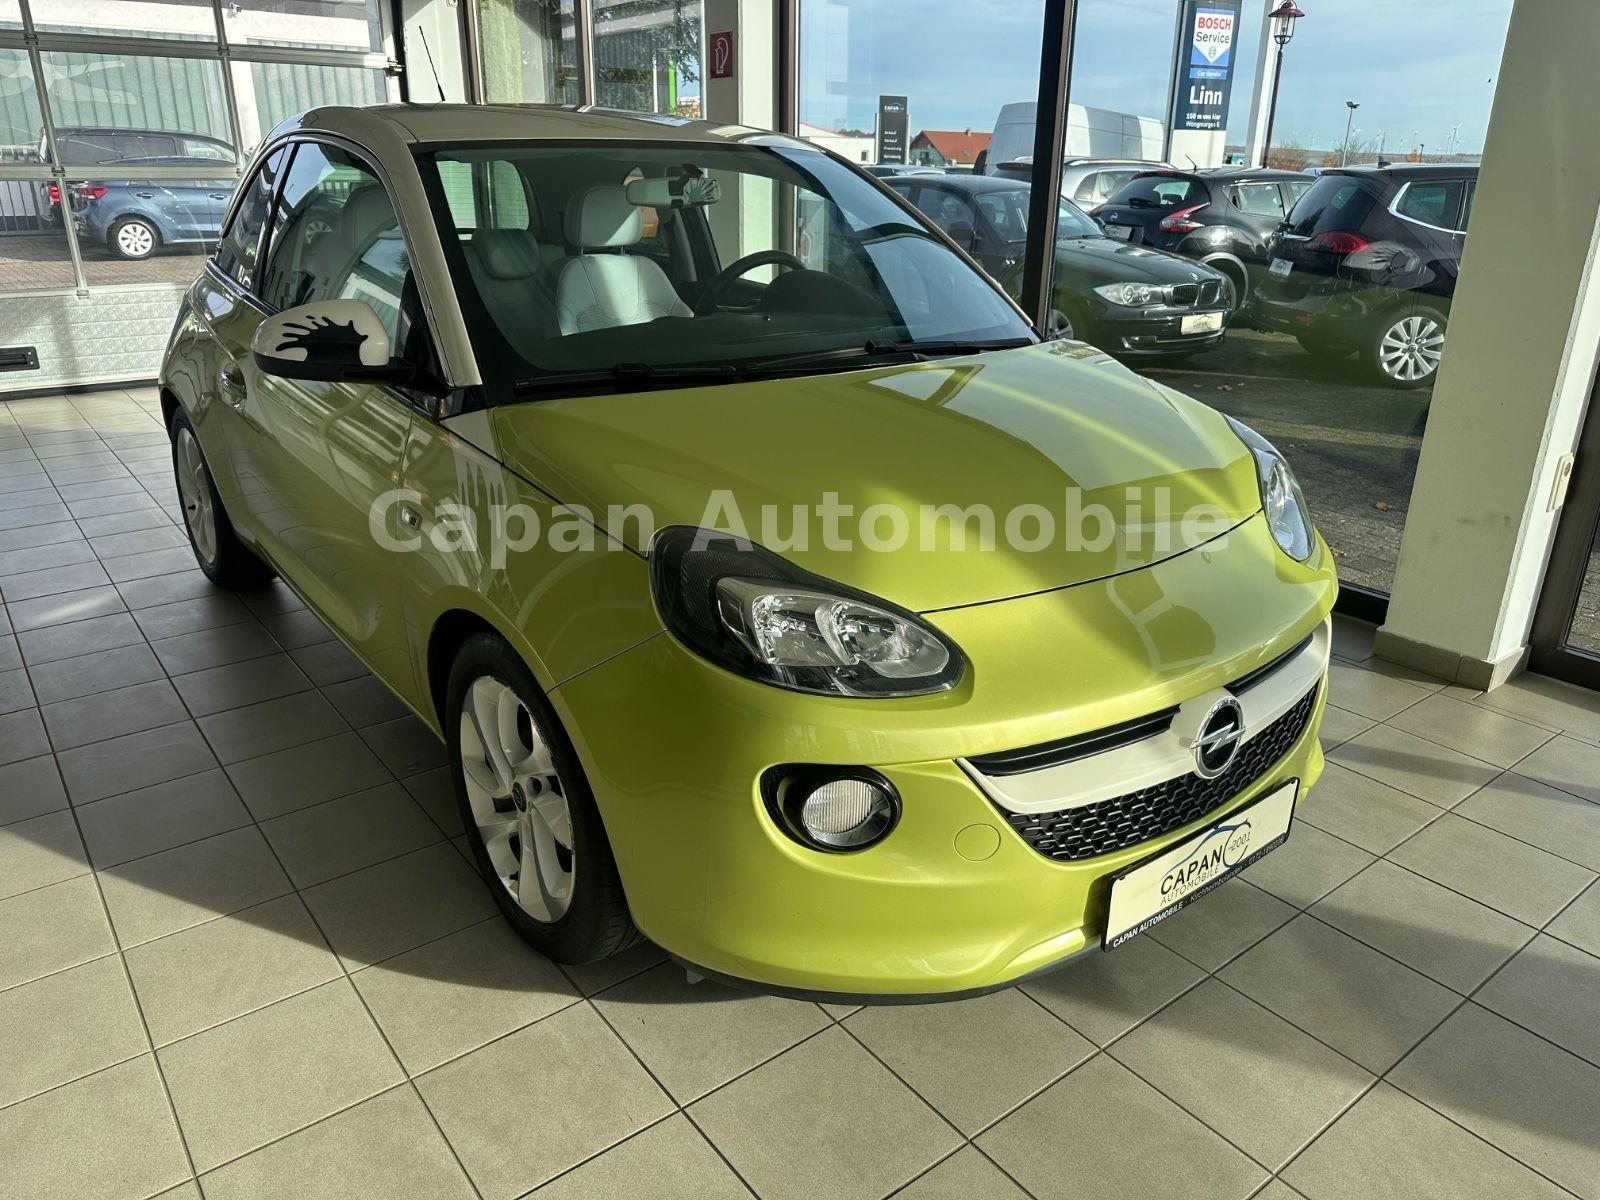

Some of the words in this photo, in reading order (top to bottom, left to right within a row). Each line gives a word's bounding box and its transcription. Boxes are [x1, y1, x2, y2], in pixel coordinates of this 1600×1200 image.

[1197, 16, 1232, 31] BOSCH
[1195, 31, 1230, 44] Service
[1189, 85, 1222, 105] Linn
[1185, 112, 1197, 120] 150
[1160, 845, 1223, 895] CAPAN
[1160, 863, 1220, 906] AUTOMOBILE
[1113, 928, 1138, 948] CAPAN
[1138, 901, 1184, 934] AUTOMOBILE
